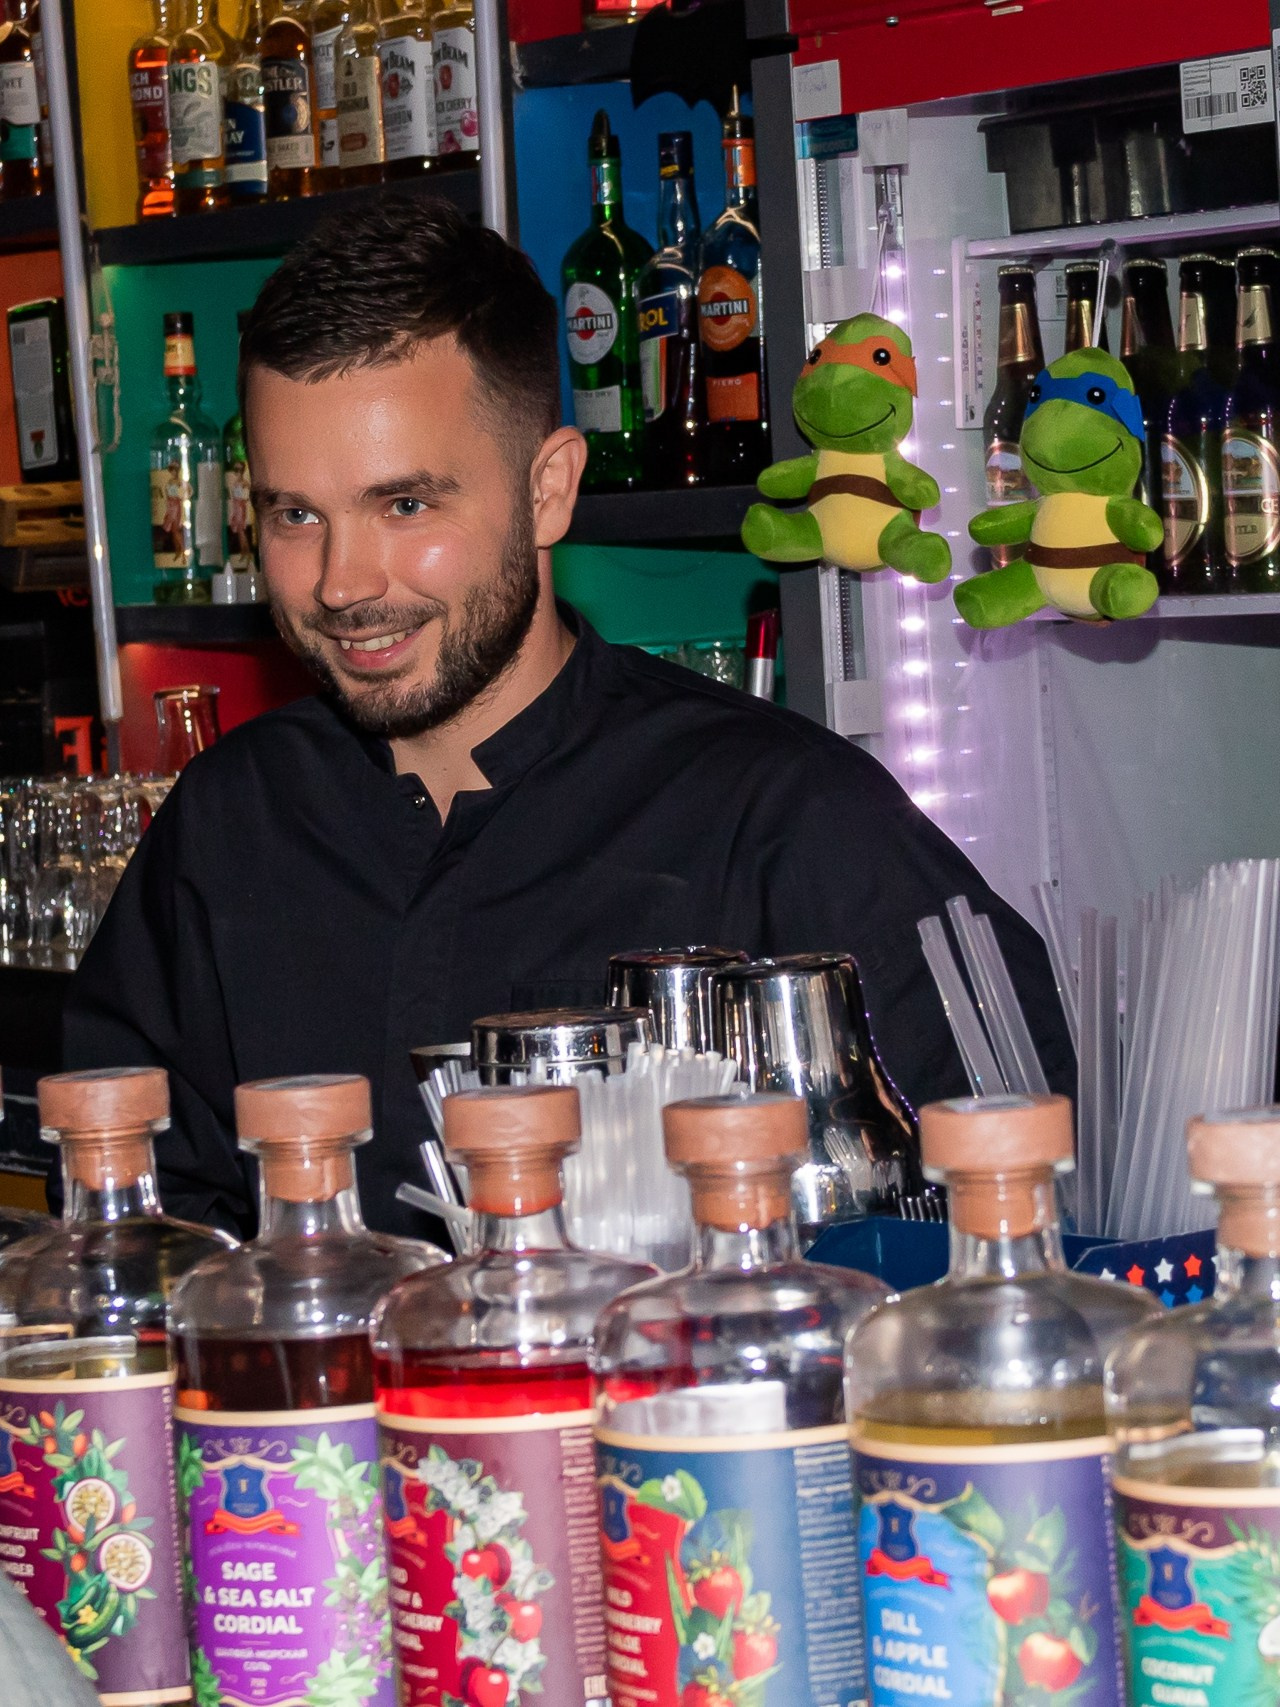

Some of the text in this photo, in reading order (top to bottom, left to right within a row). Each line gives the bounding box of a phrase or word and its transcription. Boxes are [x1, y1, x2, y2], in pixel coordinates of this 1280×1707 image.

[701, 300, 748, 316] MARTINI
[567, 314, 611, 330] MARTINI
[221, 1561, 277, 1582] SAGE
[204, 1585, 316, 1608] & SEA SALT
[214, 1613, 303, 1635] CORDIAL
[885, 1639, 949, 1669] APPLE
[874, 1664, 953, 1699] CORDIAL
